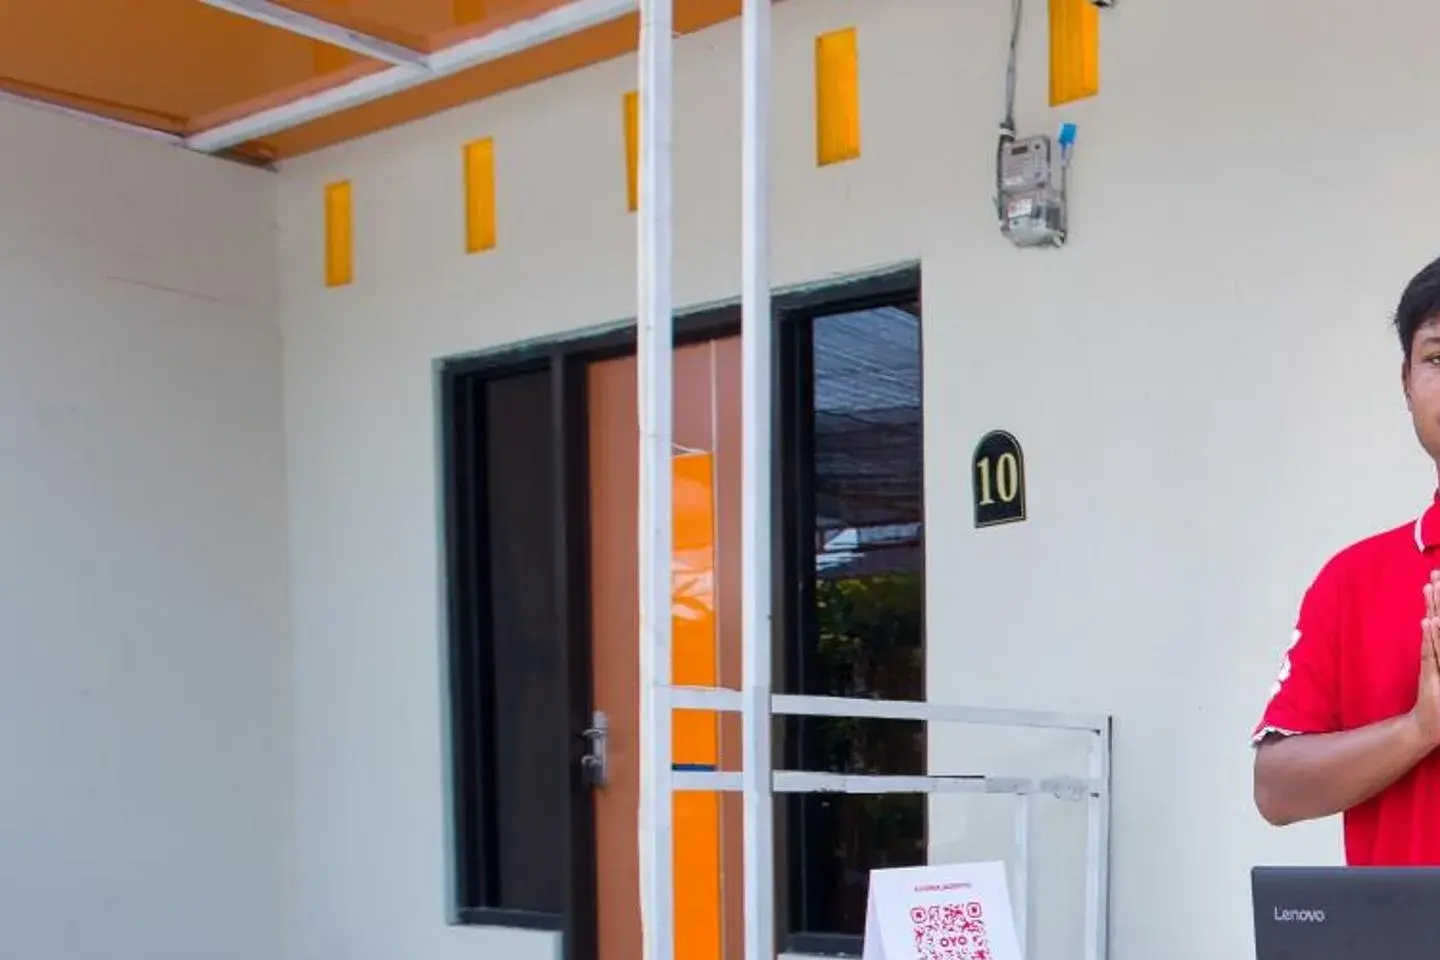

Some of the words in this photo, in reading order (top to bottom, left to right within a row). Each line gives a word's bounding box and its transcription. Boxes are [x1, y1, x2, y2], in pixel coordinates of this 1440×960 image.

[976, 452, 1019, 506] 10
[1274, 905, 1326, 922] Lenovo
[939, 935, 968, 948] OYO
